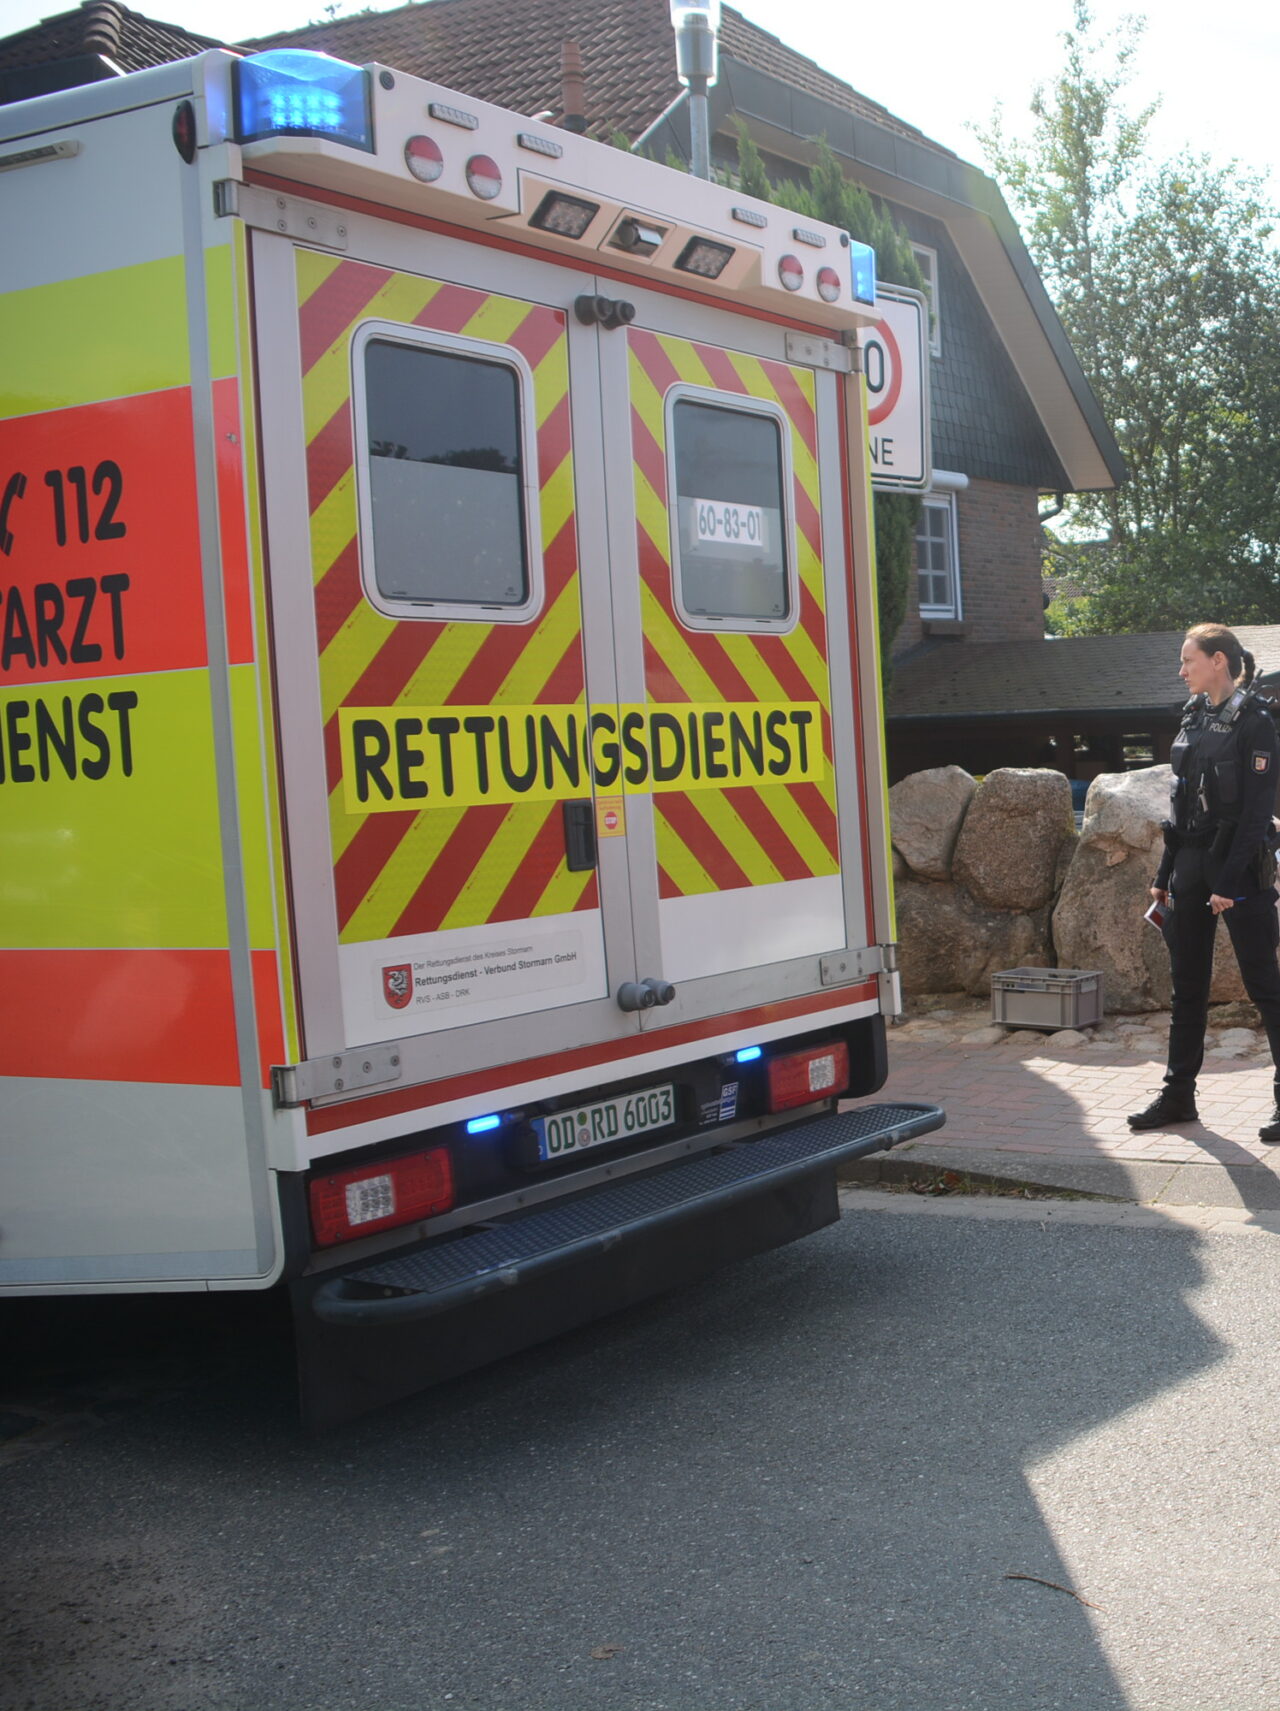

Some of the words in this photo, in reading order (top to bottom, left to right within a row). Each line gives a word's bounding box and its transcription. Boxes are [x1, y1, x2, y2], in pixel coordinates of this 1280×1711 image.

[863, 339, 885, 394] 0
[868, 436, 894, 466] NE
[45, 460, 126, 547] 112
[699, 503, 761, 541] 60-83-01
[0, 573, 130, 672] ARZT
[352, 710, 813, 803] RETTUNGSDIENST
[414, 969, 478, 987] Rettungsdienst
[484, 962, 517, 975] Verbund
[518, 957, 553, 969] Stormarn
[554, 952, 577, 963] GmbH
[547, 1115, 576, 1154] OD
[591, 1104, 619, 1141] RD
[624, 1089, 672, 1131] 6003
